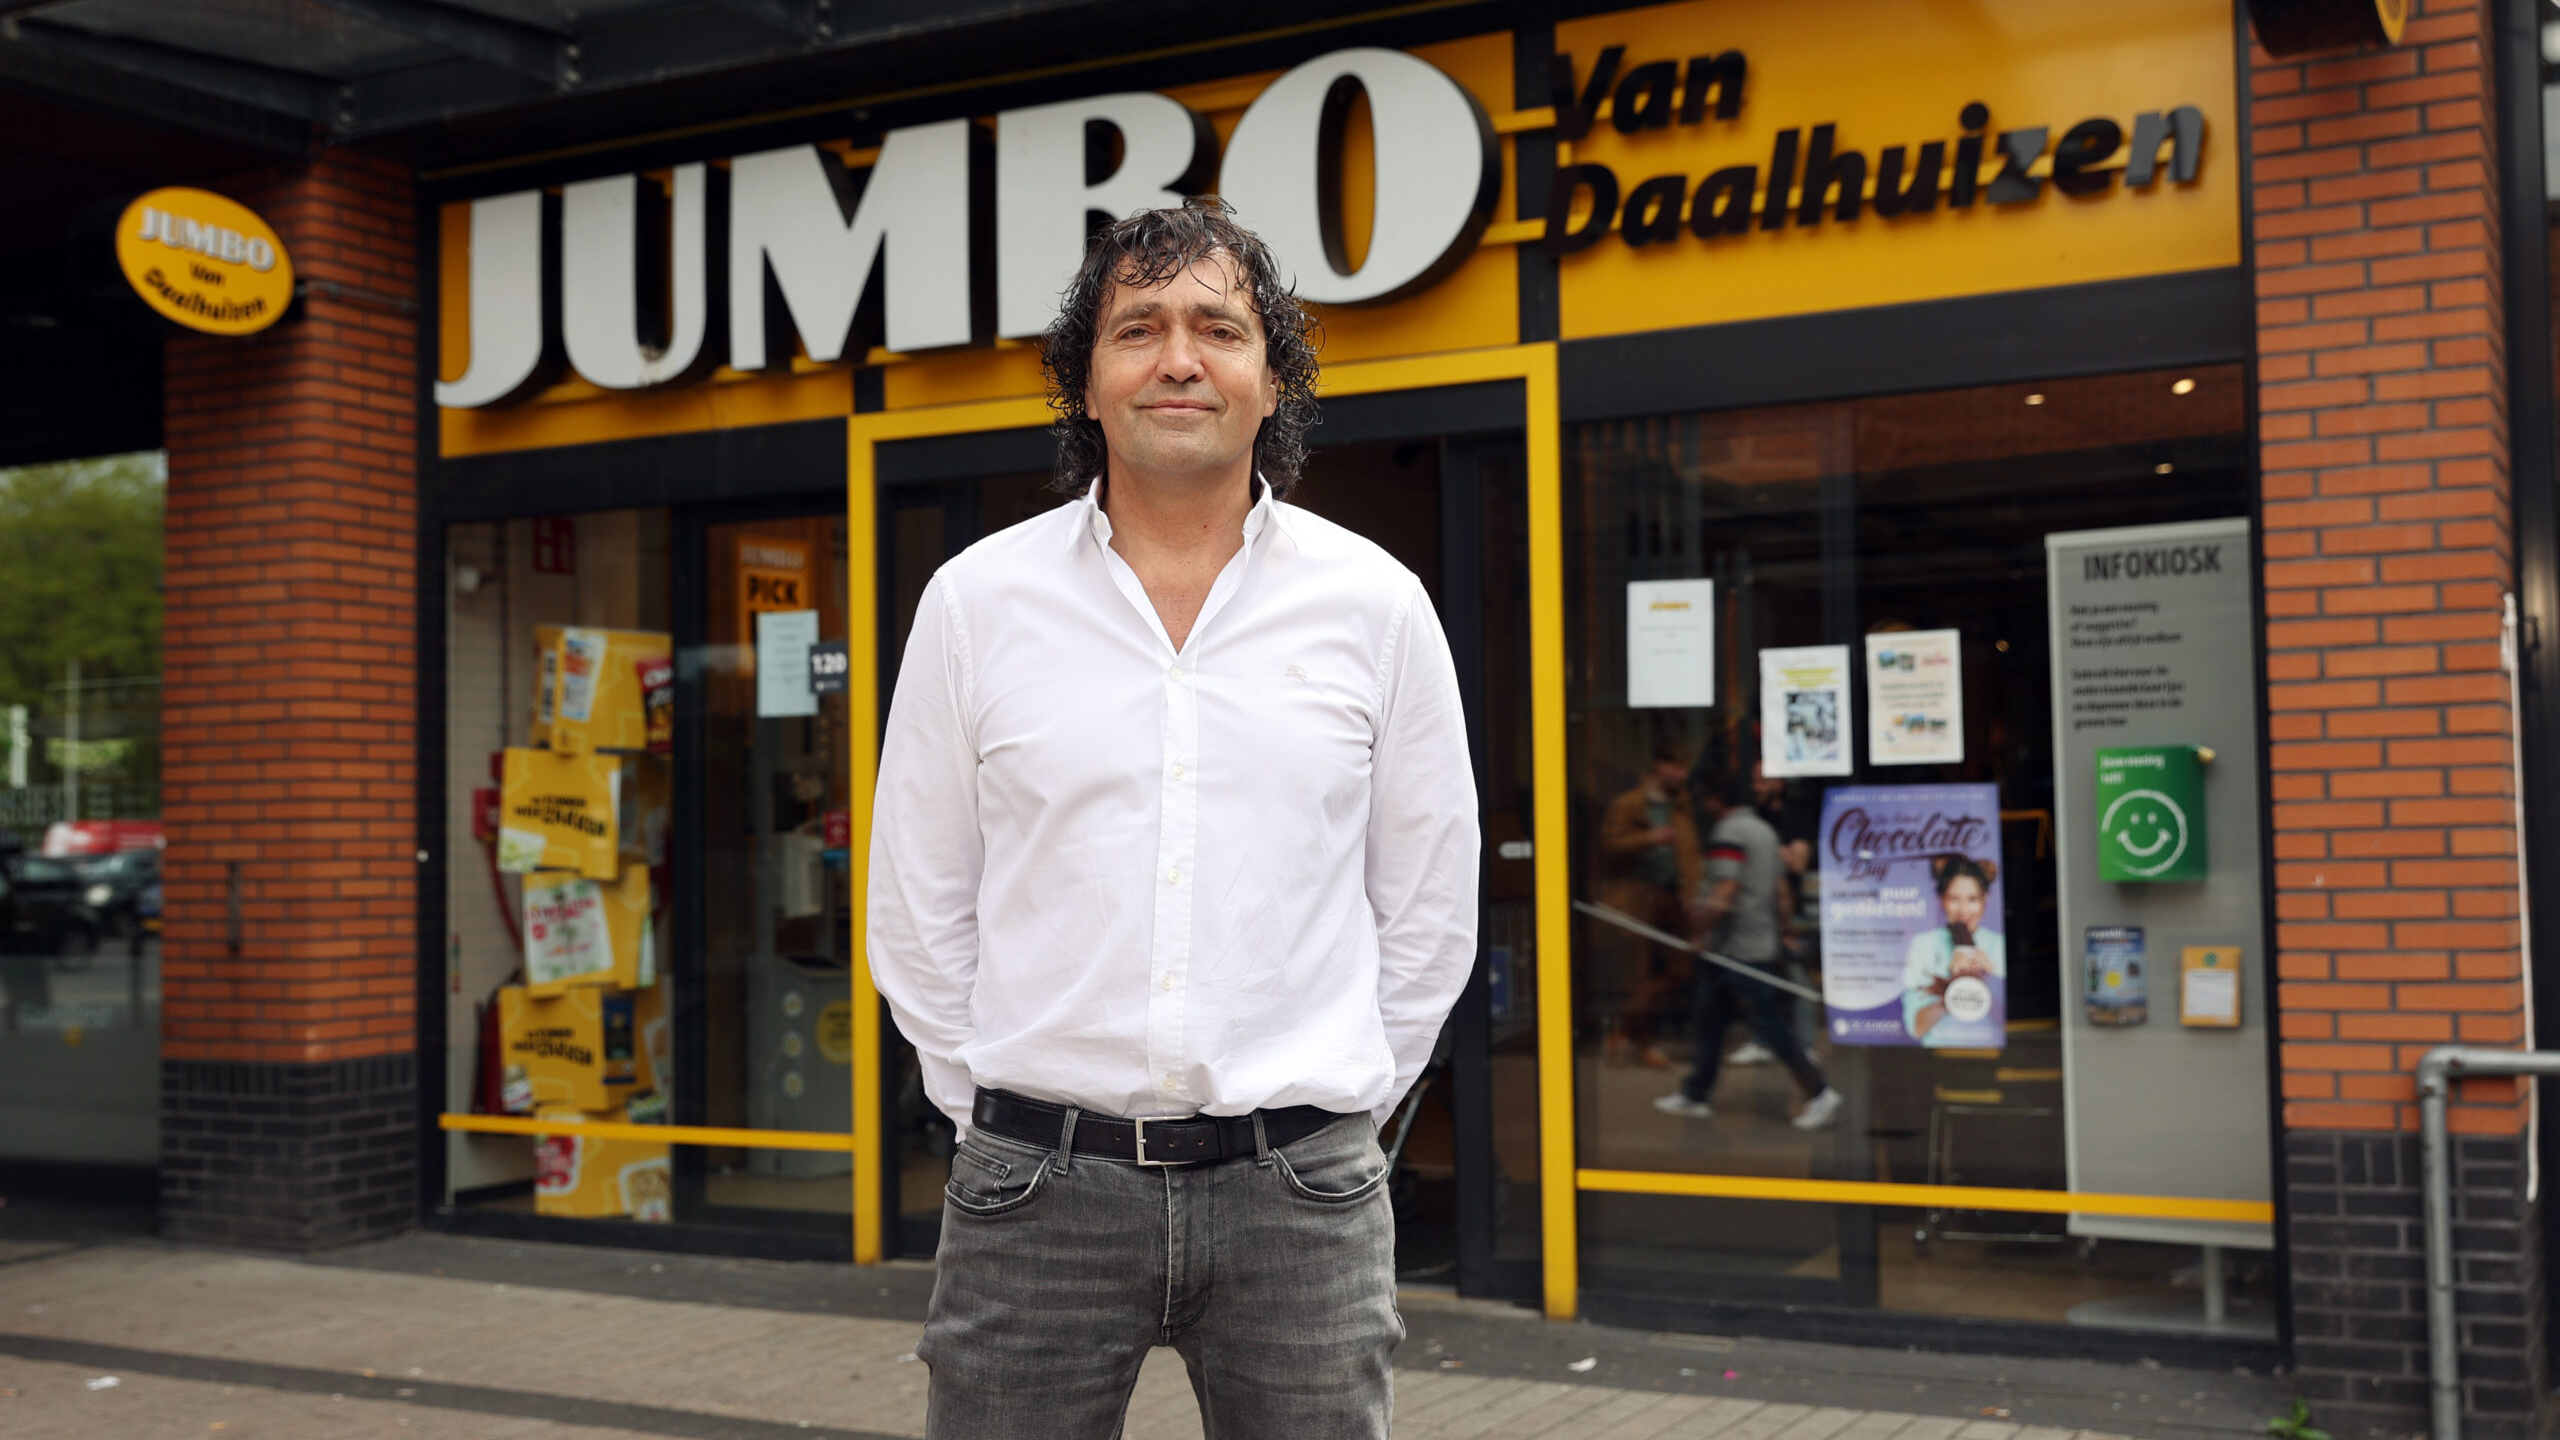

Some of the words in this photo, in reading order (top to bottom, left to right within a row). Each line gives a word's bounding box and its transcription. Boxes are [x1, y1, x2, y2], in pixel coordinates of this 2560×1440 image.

[1550, 43, 1747, 140] Van
[1545, 101, 2206, 258] Daalhuizen
[137, 206, 276, 271] JUMBO
[434, 46, 1486, 408] JUMBO
[190, 262, 225, 287] Van
[2083, 545, 2222, 583] INFOKIOSK
[748, 574, 799, 604] PICK
[811, 652, 848, 674] 120
[1830, 807, 1985, 862] Chocolate
[1847, 857, 1889, 882] Day
